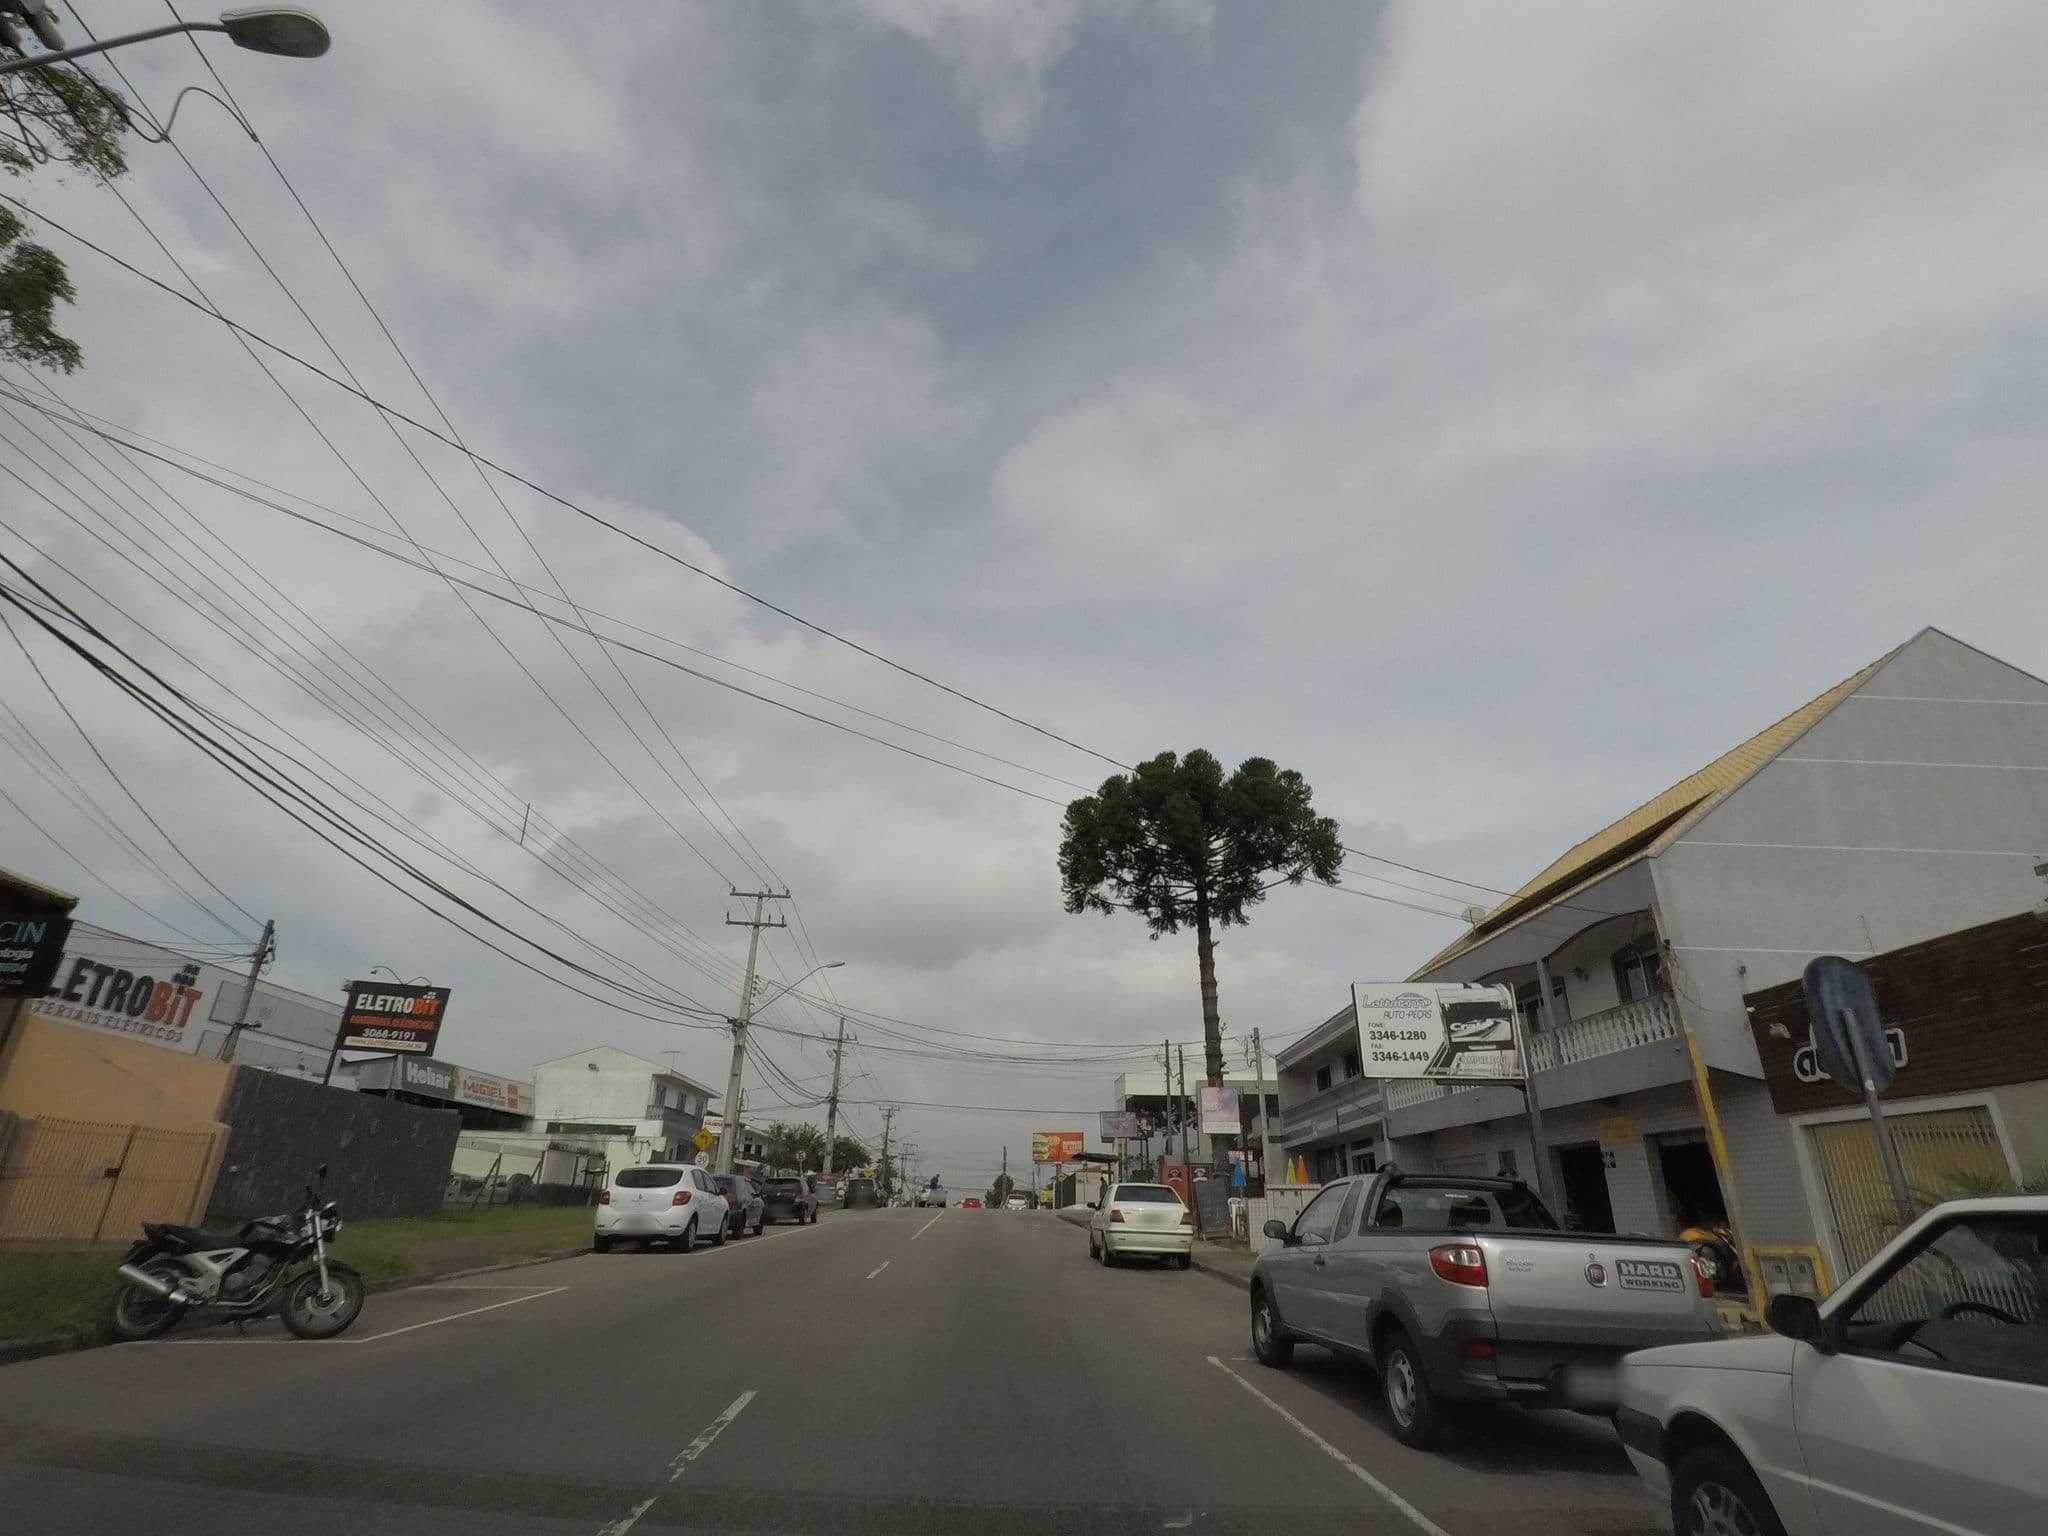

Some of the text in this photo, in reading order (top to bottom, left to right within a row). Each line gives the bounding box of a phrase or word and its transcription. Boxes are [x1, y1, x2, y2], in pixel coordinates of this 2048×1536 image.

[362, 1027, 417, 1041] 3068-9191
[1369, 1030, 1427, 1041] 3346-1280
[1371, 1051, 1430, 1062] 3346-1449
[1620, 1262, 1677, 1278] HARD
[1624, 1278, 1680, 1289] WORKING
